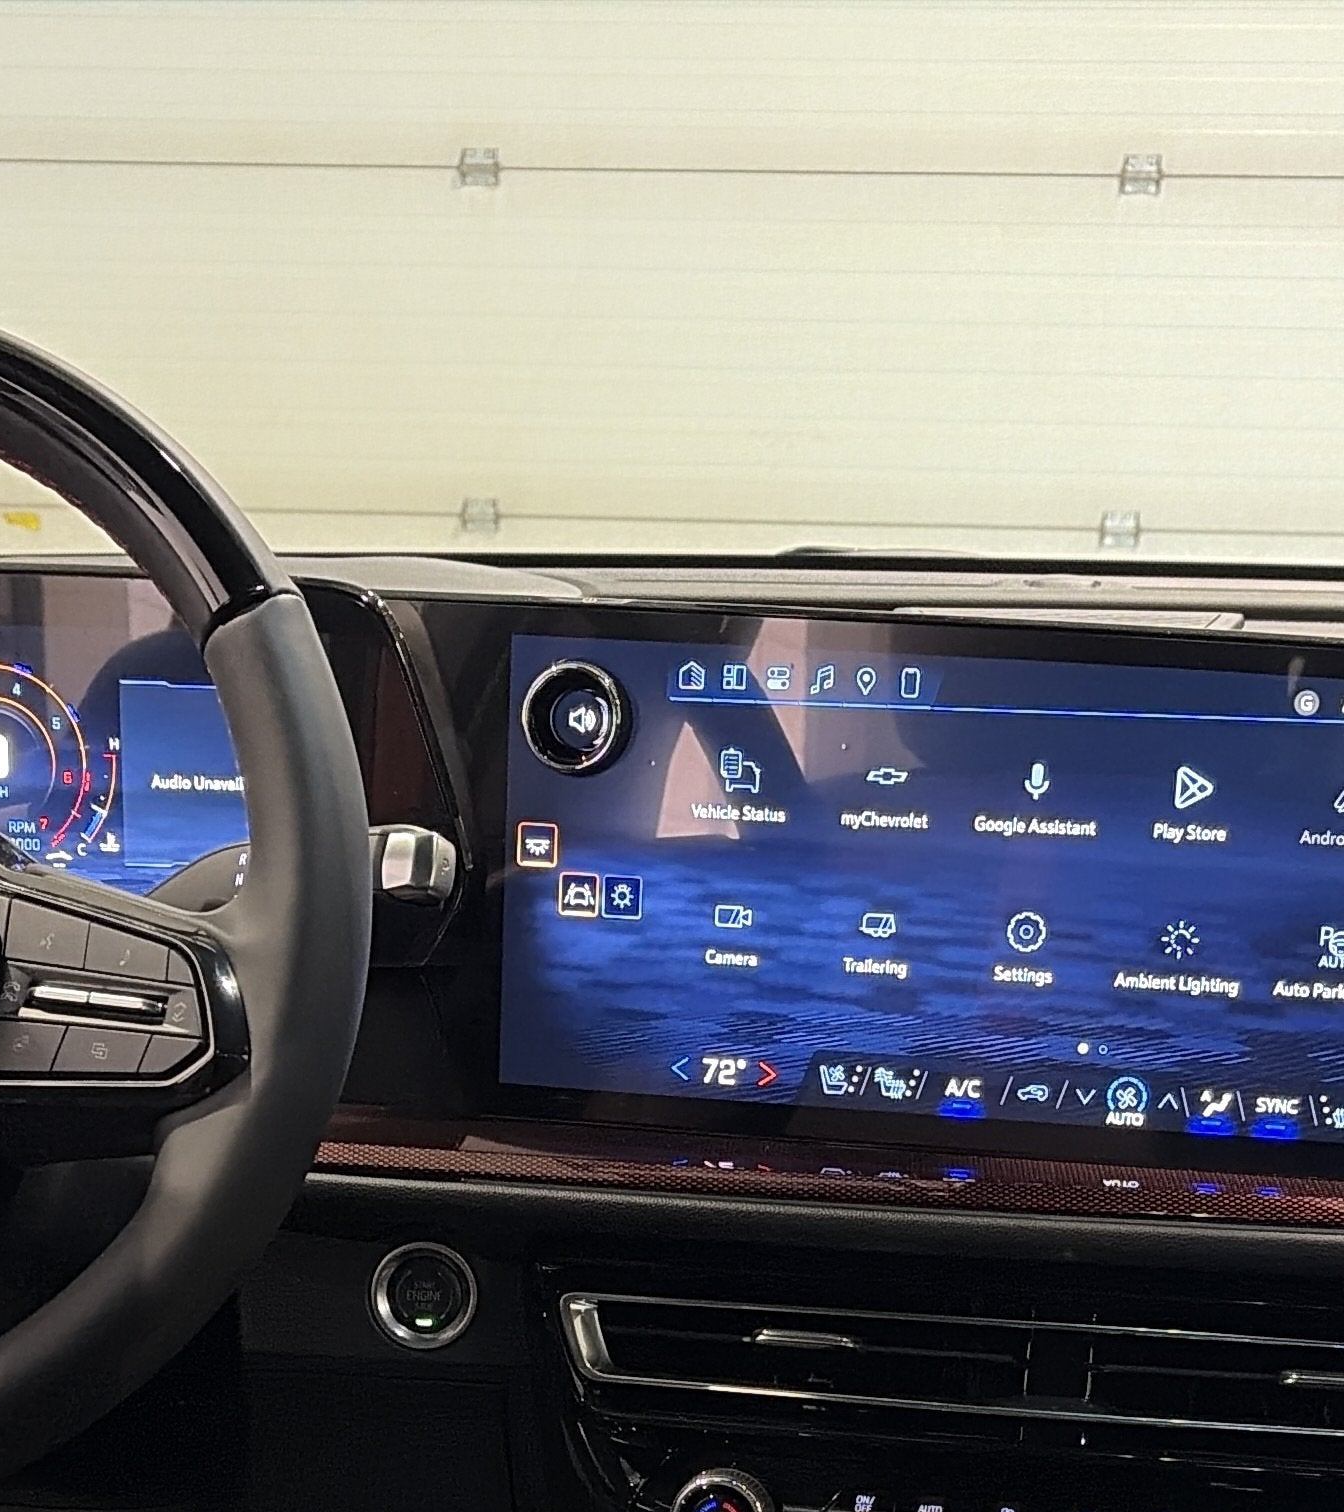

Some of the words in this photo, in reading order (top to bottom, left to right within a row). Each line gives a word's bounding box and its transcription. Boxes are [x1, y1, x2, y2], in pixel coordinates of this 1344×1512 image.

[12, 682, 22, 695] 4
[52, 717, 61, 731] 5
[108, 737, 120, 751] H
[63, 771, 73, 784] 6
[151, 774, 192, 790] Audio
[691, 803, 740, 820] Vehicle
[742, 805, 786, 823] Status
[840, 811, 929, 830] myChevrolet
[8, 820, 36, 834] RPM
[39, 818, 49, 830] 7
[974, 815, 1026, 837] Google
[1027, 818, 1097, 837] Assistant
[1153, 823, 1184, 844] Play
[1185, 825, 1227, 842] Store
[77, 843, 88, 857] C
[705, 949, 758, 967] Camera
[843, 957, 907, 980] Trailering
[993, 965, 1053, 987] Settings
[1113, 972, 1176, 991] Ambient
[1178, 976, 1240, 998] Lighting
[1272, 980, 1311, 998] Auto
[701, 1057, 747, 1086] 72°
[945, 1078, 981, 1099] A/C
[1255, 1096, 1300, 1115] SYNC
[1105, 1111, 1145, 1127] AUTO
[855, 1504, 872, 1512] OFF
[856, 1495, 875, 1505] ON/
